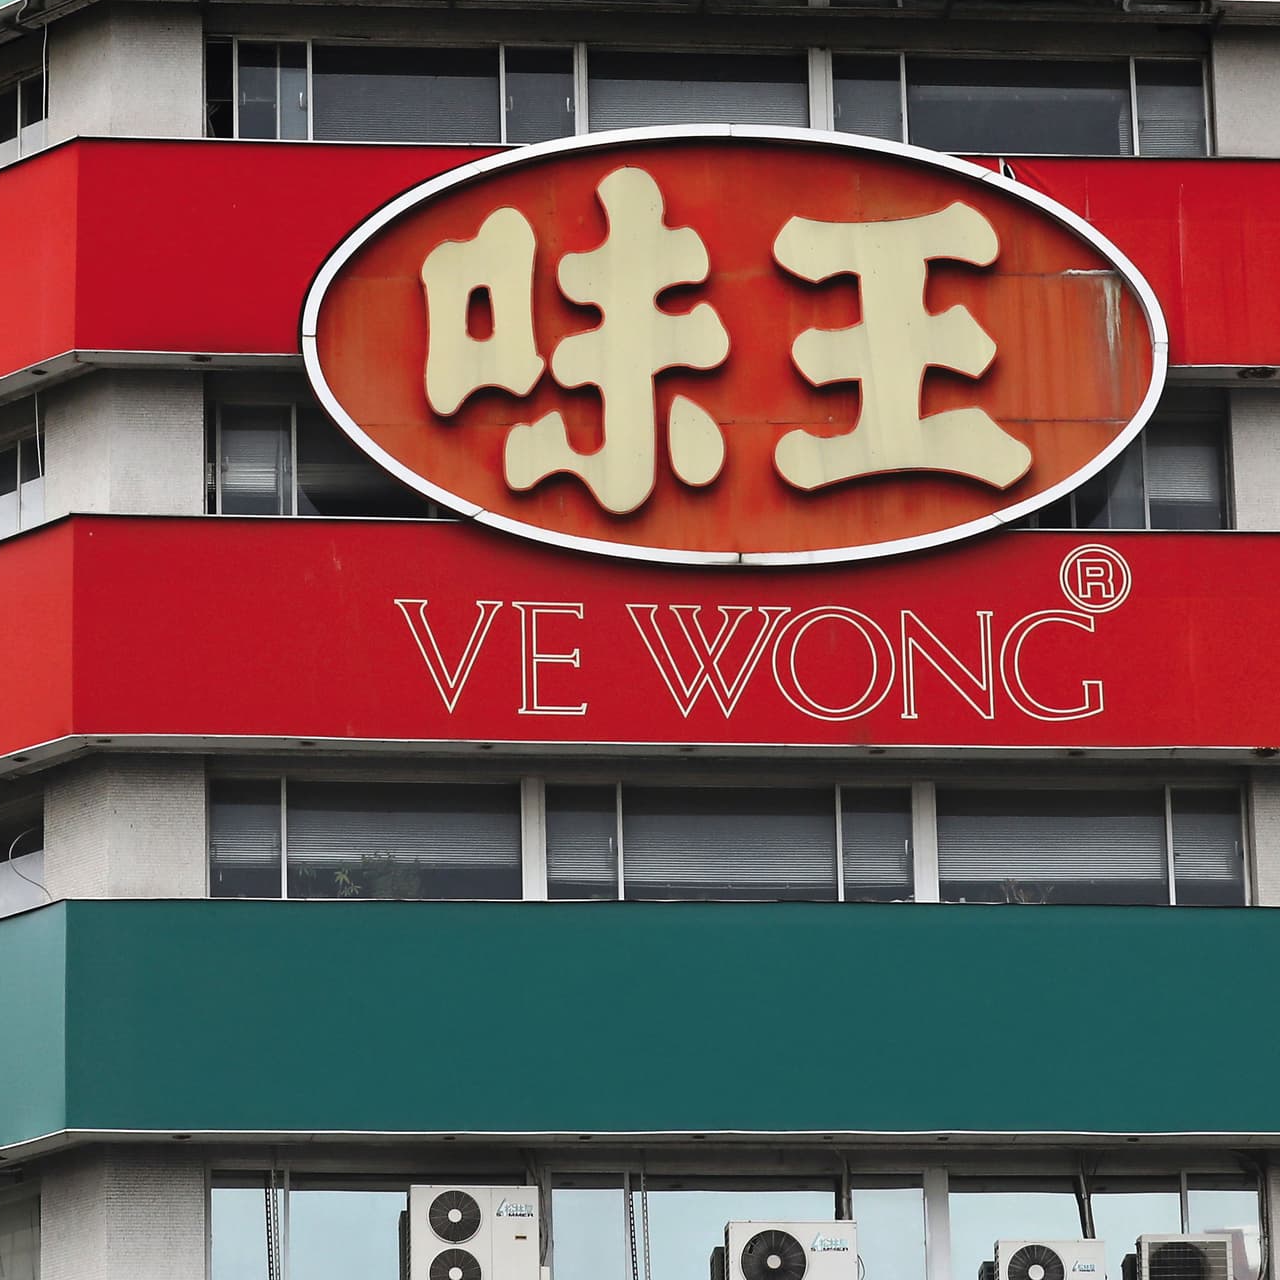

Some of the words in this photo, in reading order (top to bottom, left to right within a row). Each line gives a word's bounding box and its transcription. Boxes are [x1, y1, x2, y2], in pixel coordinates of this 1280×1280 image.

[421, 166, 1032, 514] 味王
[393, 598, 588, 716] VE
[624, 603, 1105, 722] WONG
